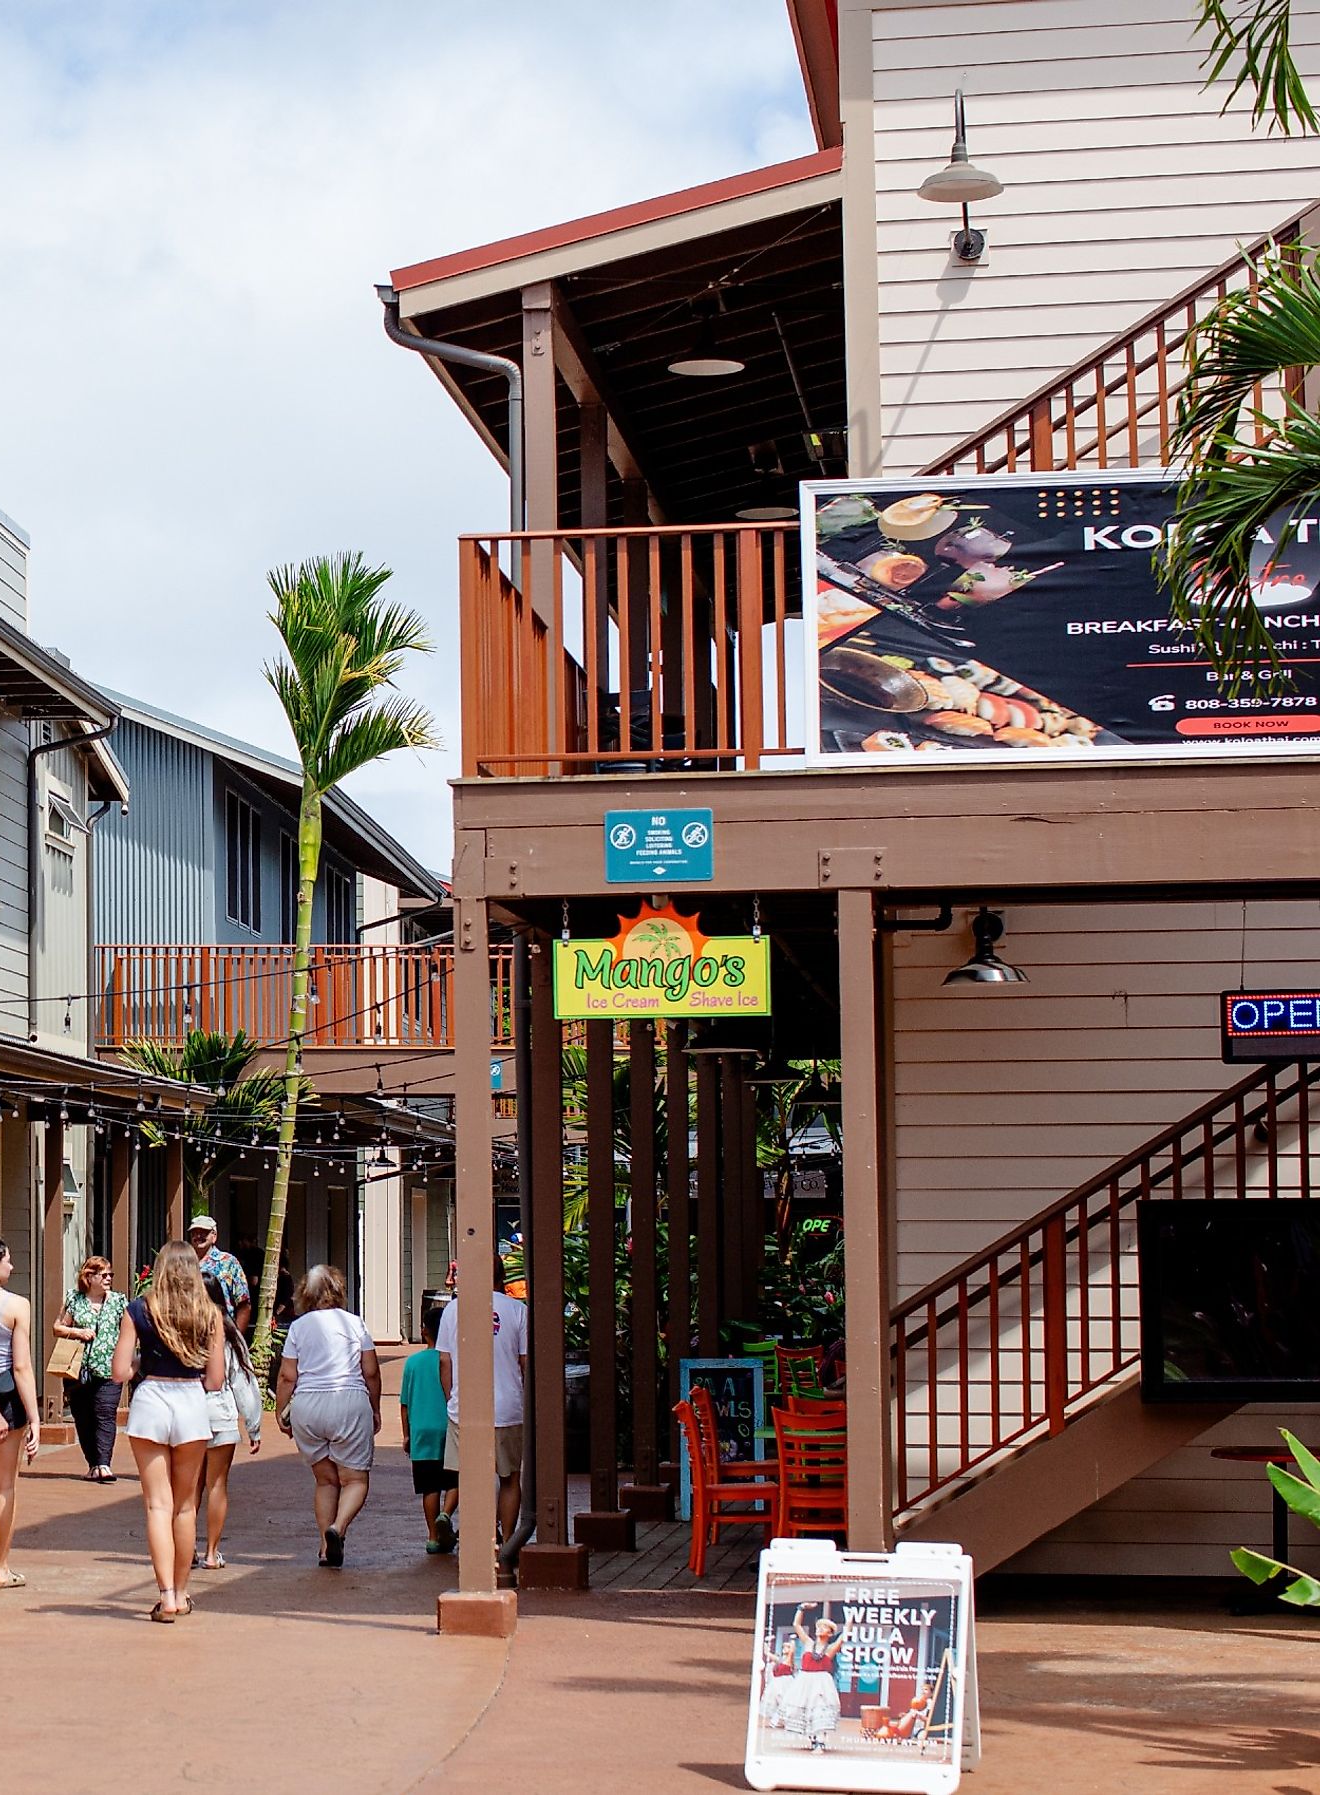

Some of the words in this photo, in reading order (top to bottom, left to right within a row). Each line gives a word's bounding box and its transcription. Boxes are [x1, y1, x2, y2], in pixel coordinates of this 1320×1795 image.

[1185, 697, 1317, 710] 808-359-7878
[1213, 721, 1251, 729] BOOK
[651, 816, 666, 826] NO
[574, 949, 745, 1001] Mango's
[587, 993, 608, 1008] Ice
[612, 993, 659, 1009] Cream
[689, 991, 734, 1007] Shave
[737, 991, 758, 1006] Ice
[802, 1218, 831, 1232] OPE
[844, 1587, 900, 1605] FREE
[843, 1606, 937, 1626] WEEKLY
[842, 1626, 905, 1645] HULA
[840, 1645, 914, 1664] SHOW
